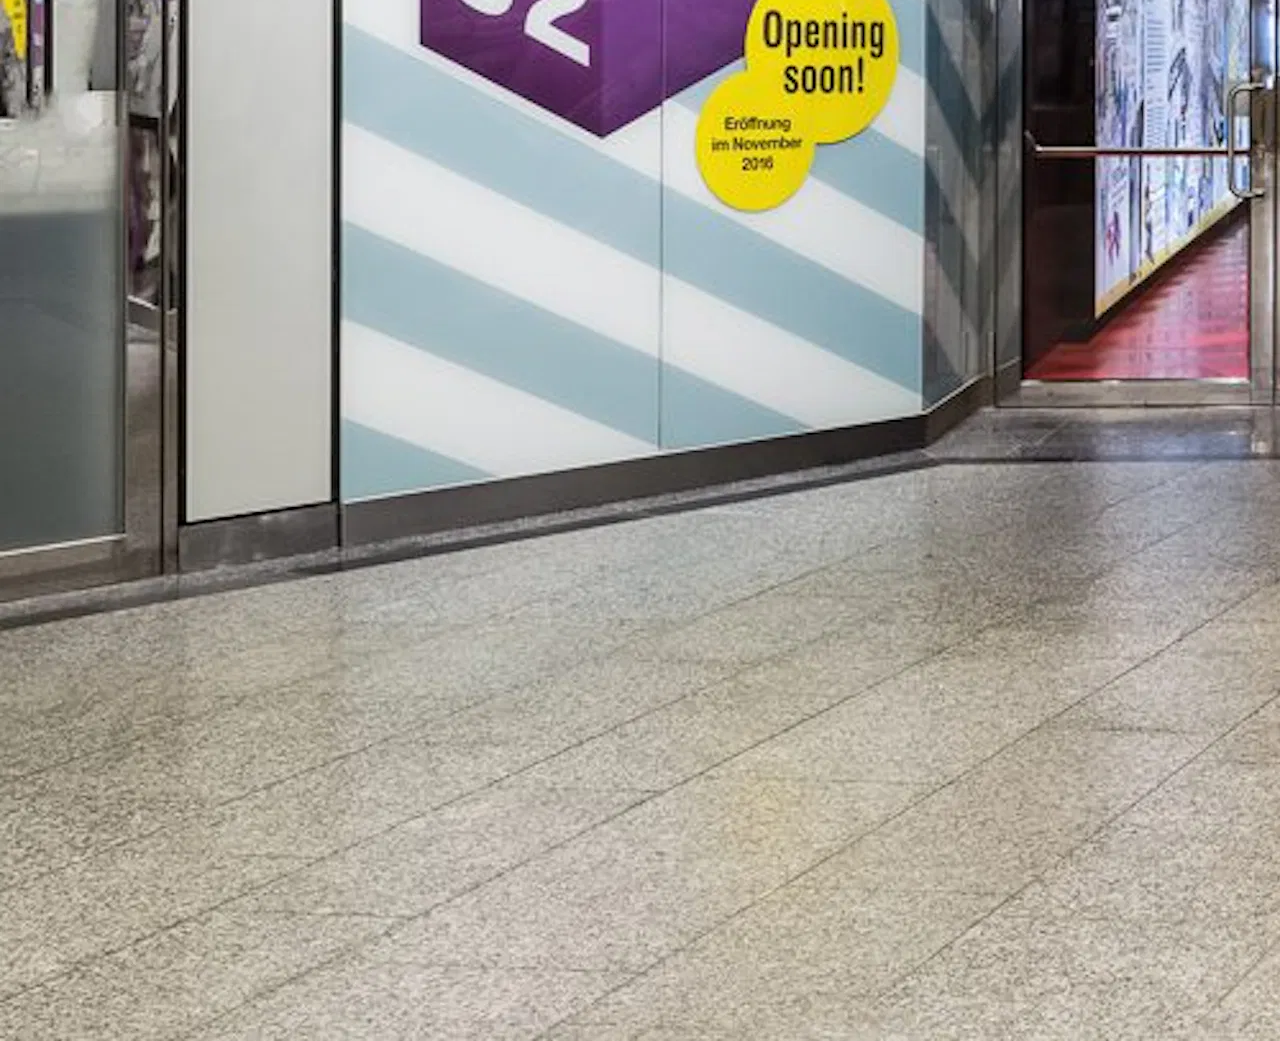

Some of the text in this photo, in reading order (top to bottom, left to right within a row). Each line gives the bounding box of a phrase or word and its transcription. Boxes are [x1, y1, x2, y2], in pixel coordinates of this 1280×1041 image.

[763, 10, 885, 58] Opening
[783, 56, 864, 94] soon!
[724, 117, 792, 132] Eröffnung
[711, 136, 802, 152] im November
[741, 156, 774, 171] 2016
